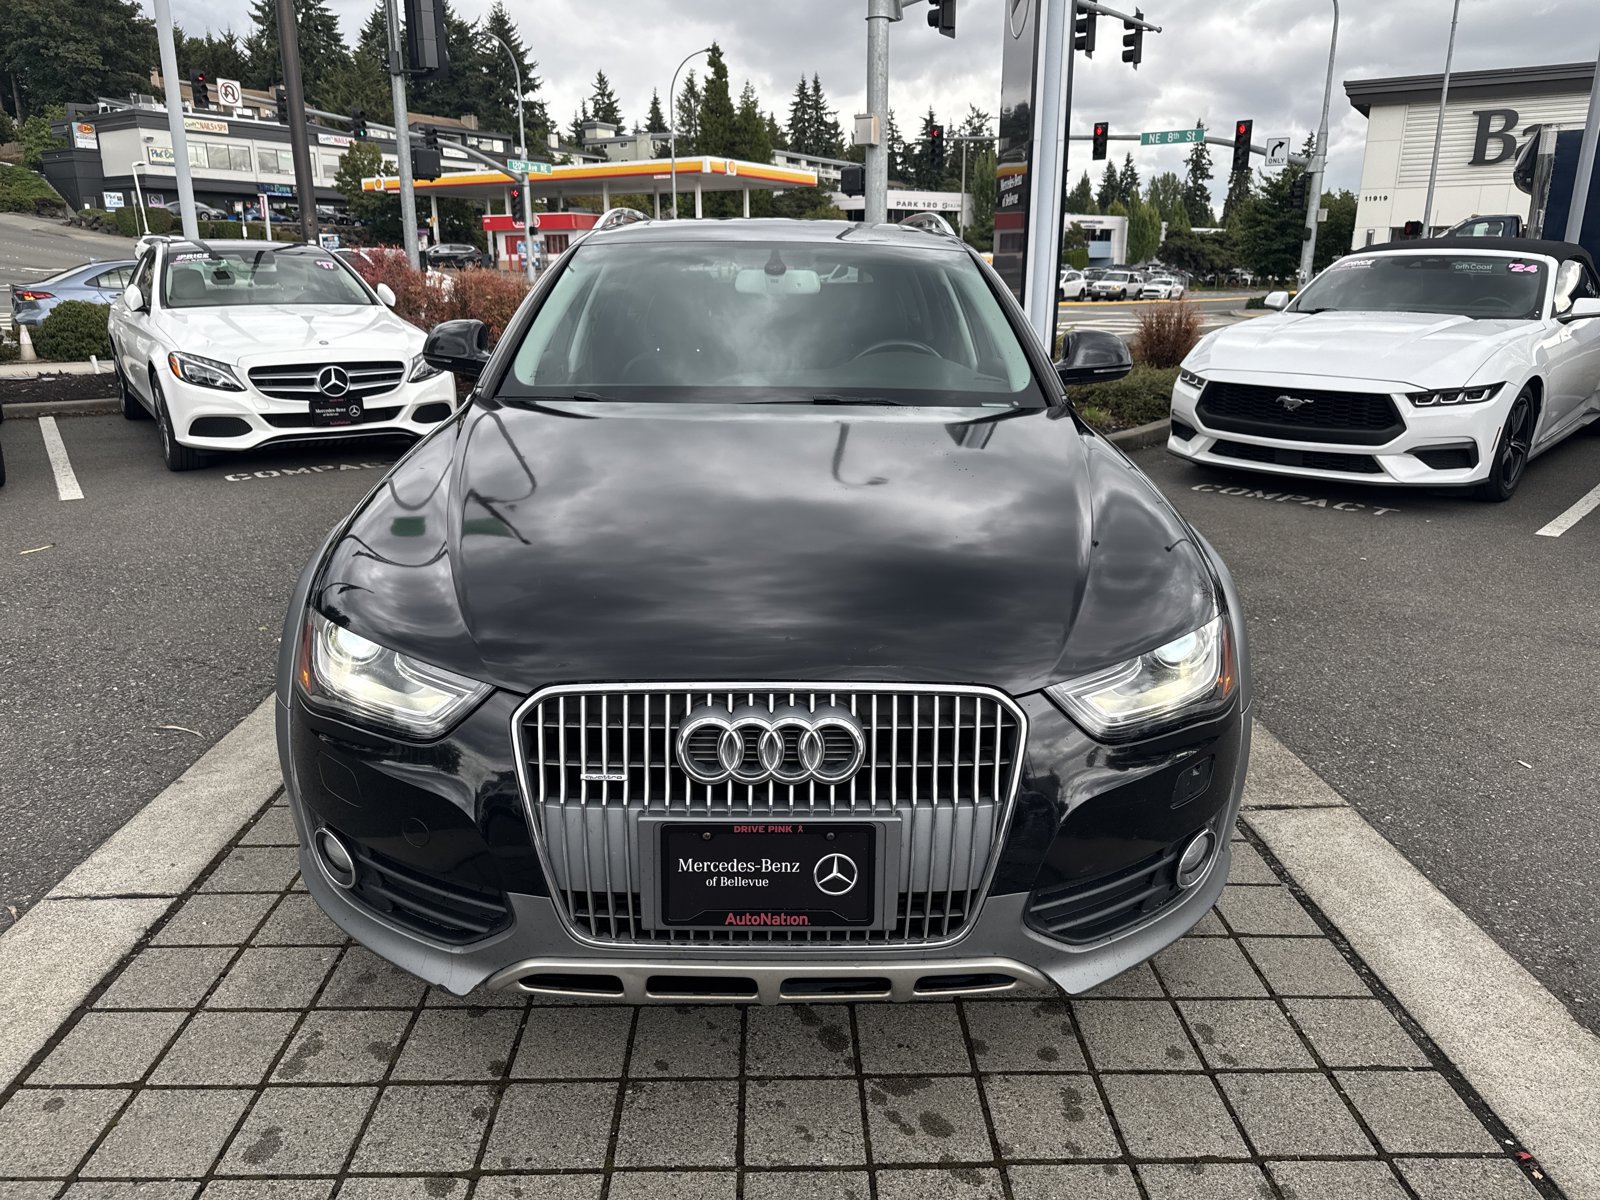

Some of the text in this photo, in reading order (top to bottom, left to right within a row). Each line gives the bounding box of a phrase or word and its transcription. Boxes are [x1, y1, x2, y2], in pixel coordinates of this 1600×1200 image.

[1149, 131, 1196, 144] NE 8th St
[512, 160, 525, 170] 120th
[1508, 263, 1538, 273] '24
[225, 461, 390, 481] COMPAC
[1192, 484, 1401, 515] COMPACT
[678, 858, 800, 872] Mercedes-Benz
[706, 876, 769, 887] of Bellevue
[725, 912, 808, 925] AutoNation
